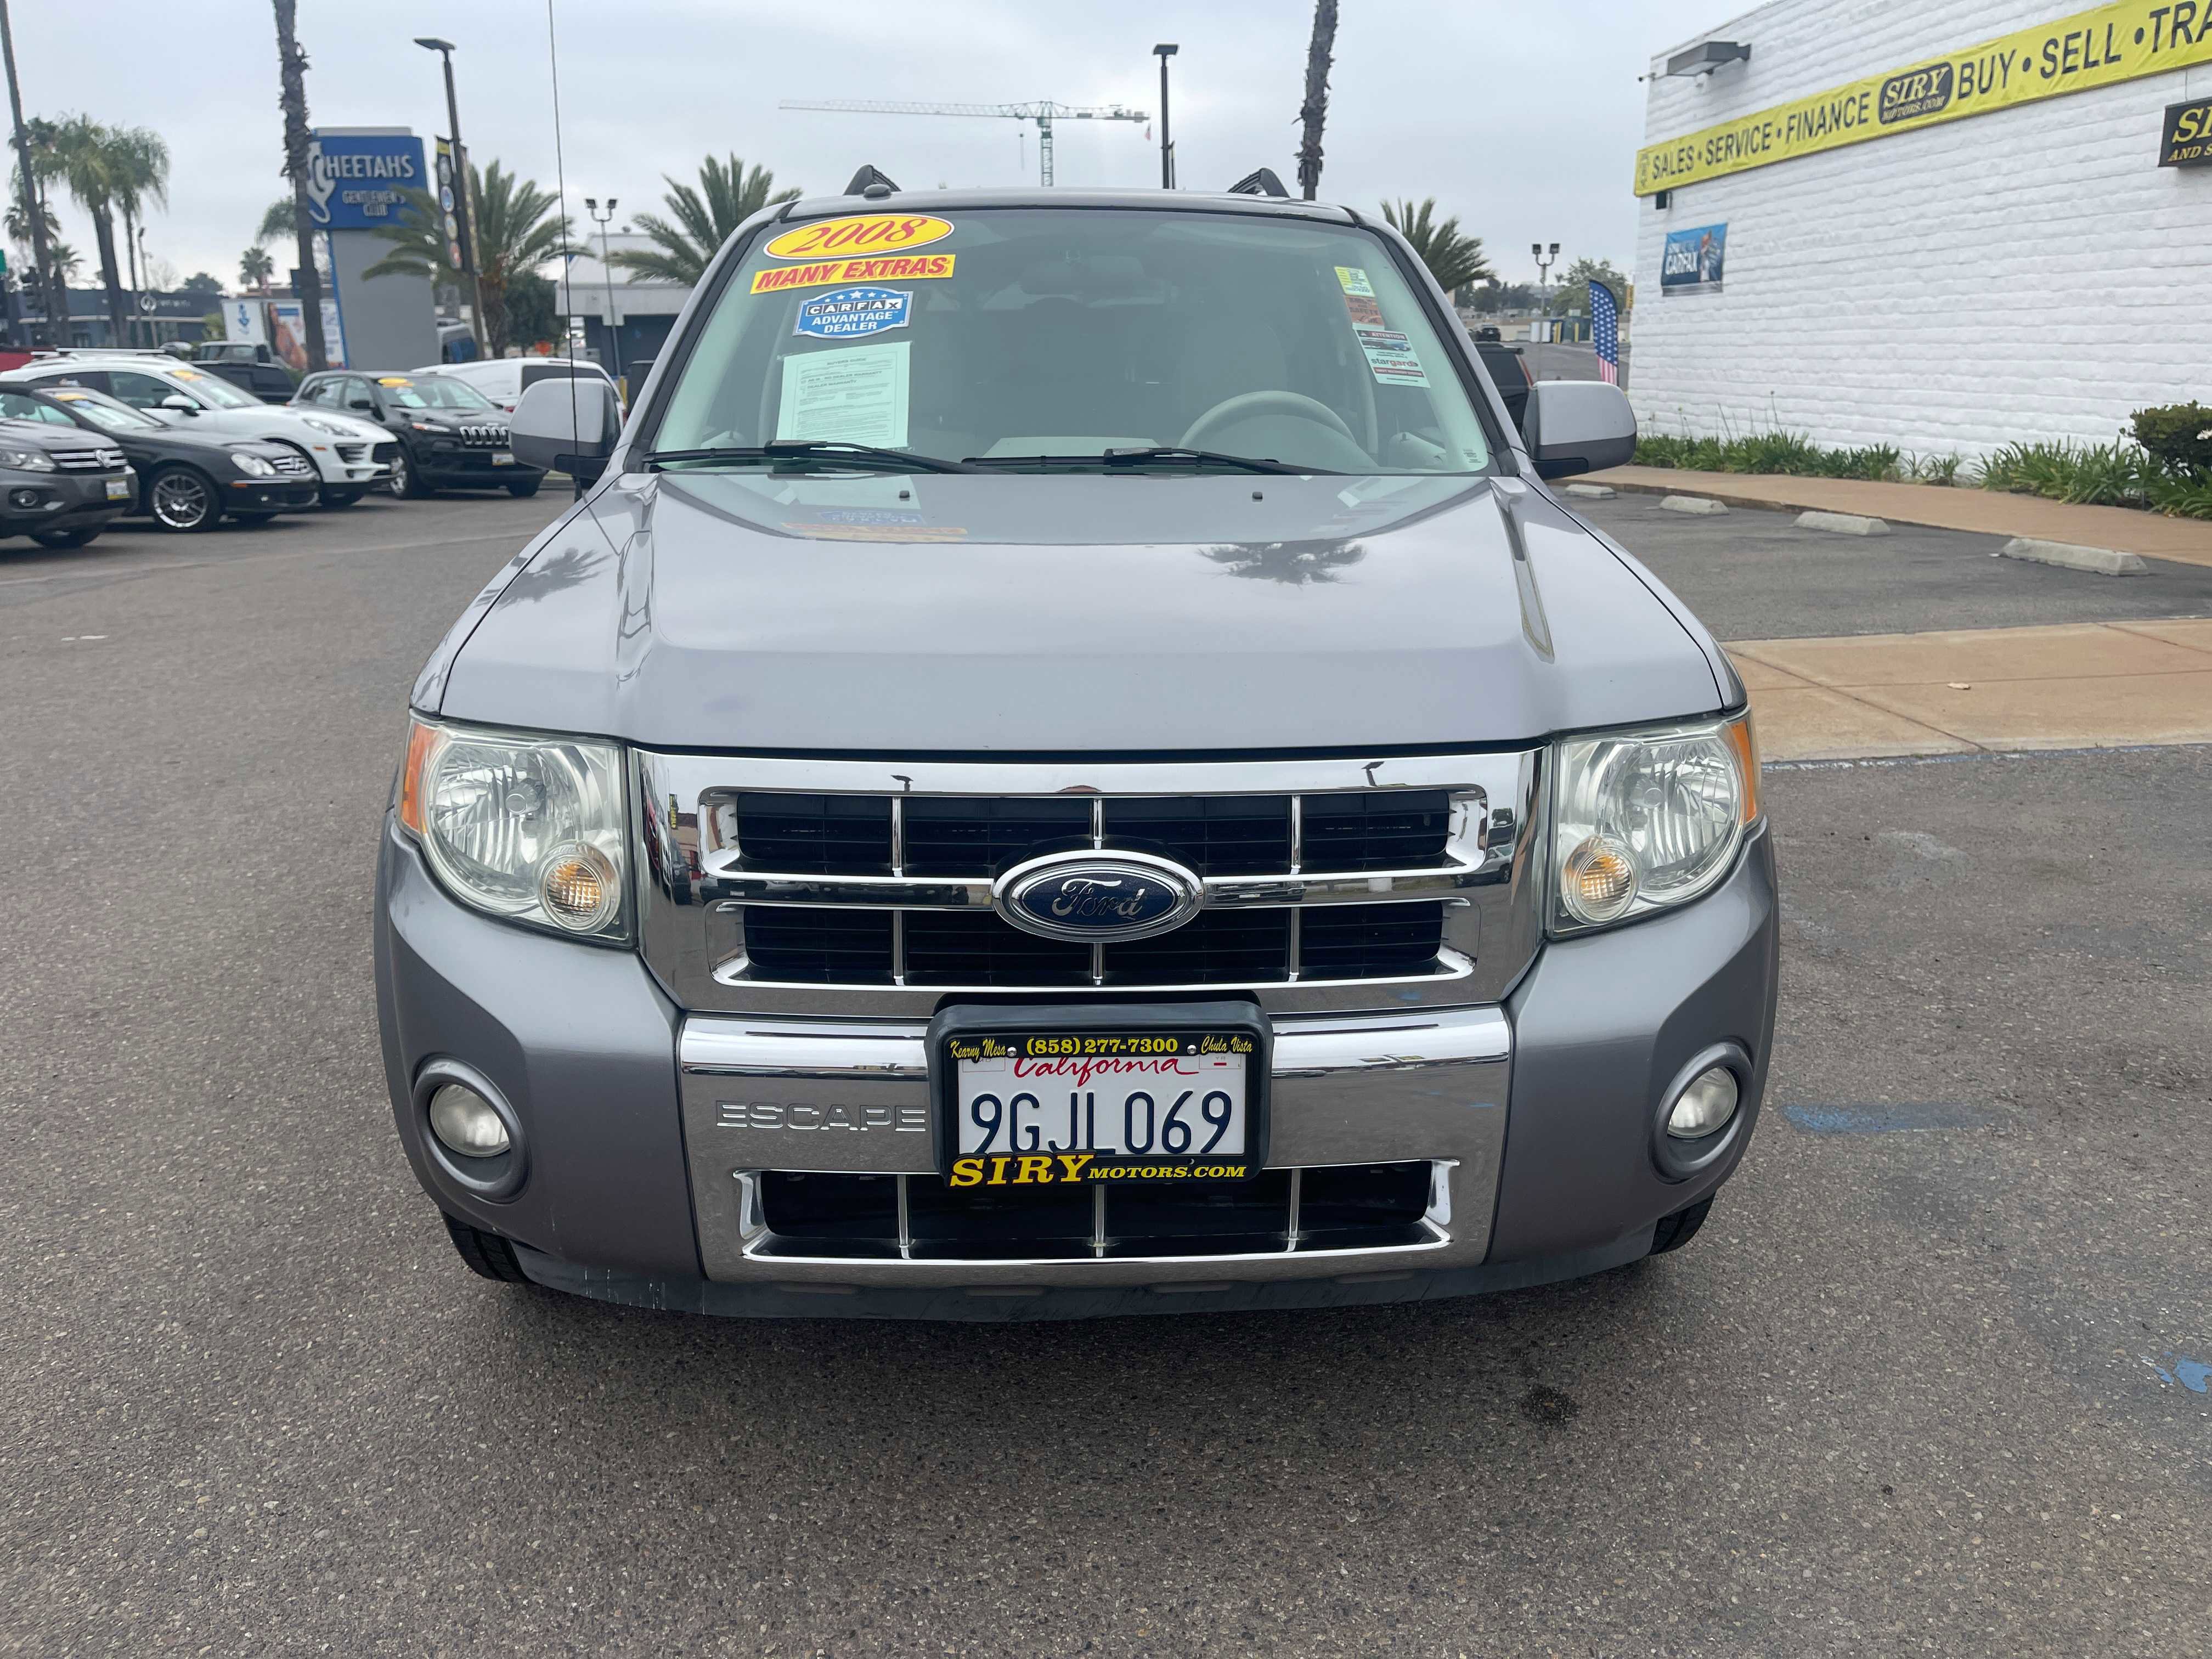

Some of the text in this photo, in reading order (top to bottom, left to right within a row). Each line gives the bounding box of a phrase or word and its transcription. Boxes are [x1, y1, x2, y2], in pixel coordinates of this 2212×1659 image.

[1958, 48, 2017, 99] BUY
[2040, 22, 2122, 79] SELL
[1883, 66, 1949, 109] SIRY
[1652, 145, 1694, 179] SALES
[1706, 122, 1772, 166] SERVICE
[1785, 92, 1870, 143] FINANCE
[2168, 146, 2202, 162] AND
[787, 218, 928, 255] 2008
[755, 257, 950, 290] MANY EXTRAS
[806, 299, 902, 315] CARFAX
[811, 311, 893, 326] ADVANTAGE
[824, 321, 878, 334] DEALER
[1051, 878, 1146, 918] Ford
[950, 1035, 1253, 1060] Kearny Mesa (858) 277-7300 Chula Vista
[1014, 1057, 1199, 1087] California
[716, 1100, 927, 1131] ESCAPE
[971, 1090, 1233, 1154] 9GJL069
[949, 1153, 1248, 1187] SIRY MOTORS.COM
